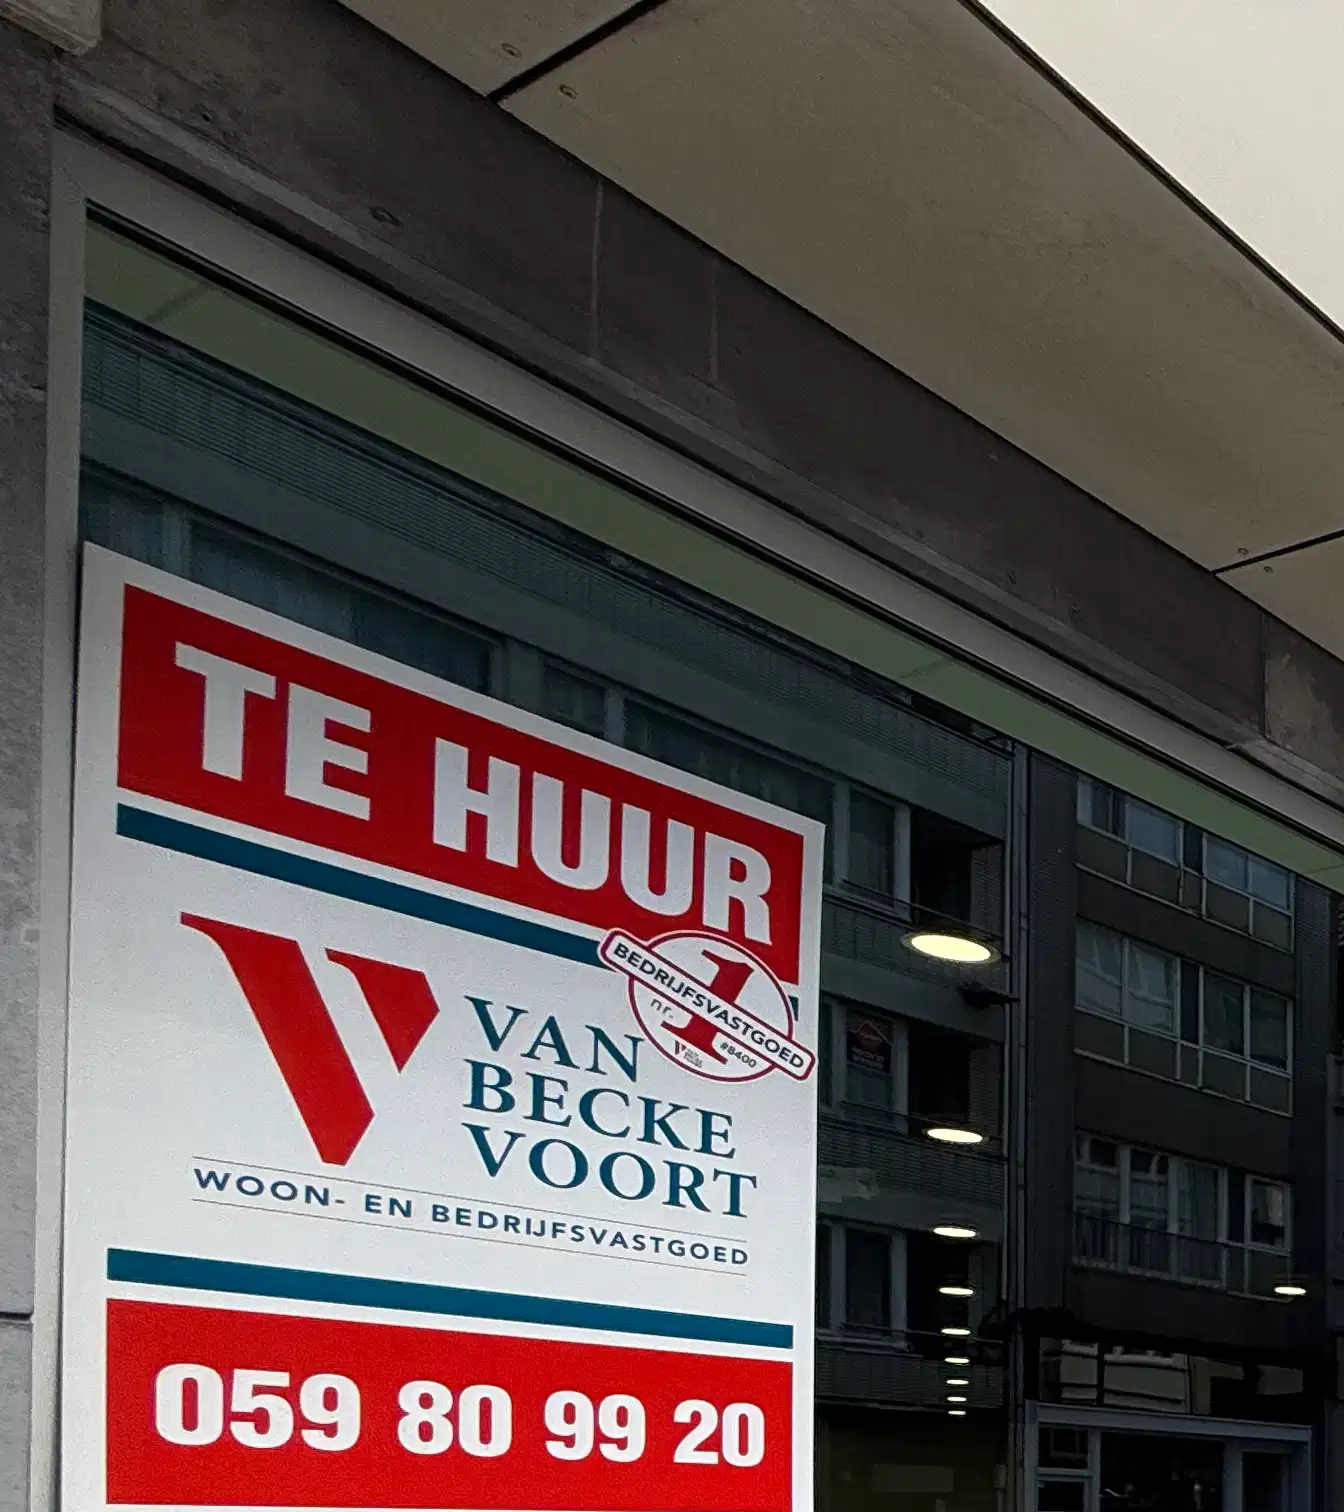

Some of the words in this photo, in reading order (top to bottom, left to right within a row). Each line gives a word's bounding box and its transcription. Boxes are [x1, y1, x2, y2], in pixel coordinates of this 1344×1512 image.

[174, 641, 371, 821] TE
[432, 736, 772, 946] HUUR
[463, 995, 646, 1082] VAN
[613, 942, 804, 1069] BEDRIJFSVASTGOED
[650, 998, 674, 1019] nr.
[719, 1041, 757, 1068] #8400
[462, 1058, 737, 1158] BECKE
[193, 1167, 345, 1207] WOON-
[364, 1193, 412, 1219] EN
[431, 1204, 749, 1266] BEDRIJFSVASTGOED
[461, 1122, 757, 1219] VOORT
[153, 1362, 361, 1452] 059
[396, 1379, 513, 1457] 80
[543, 1390, 646, 1462] 99
[672, 1398, 766, 1467] 20
